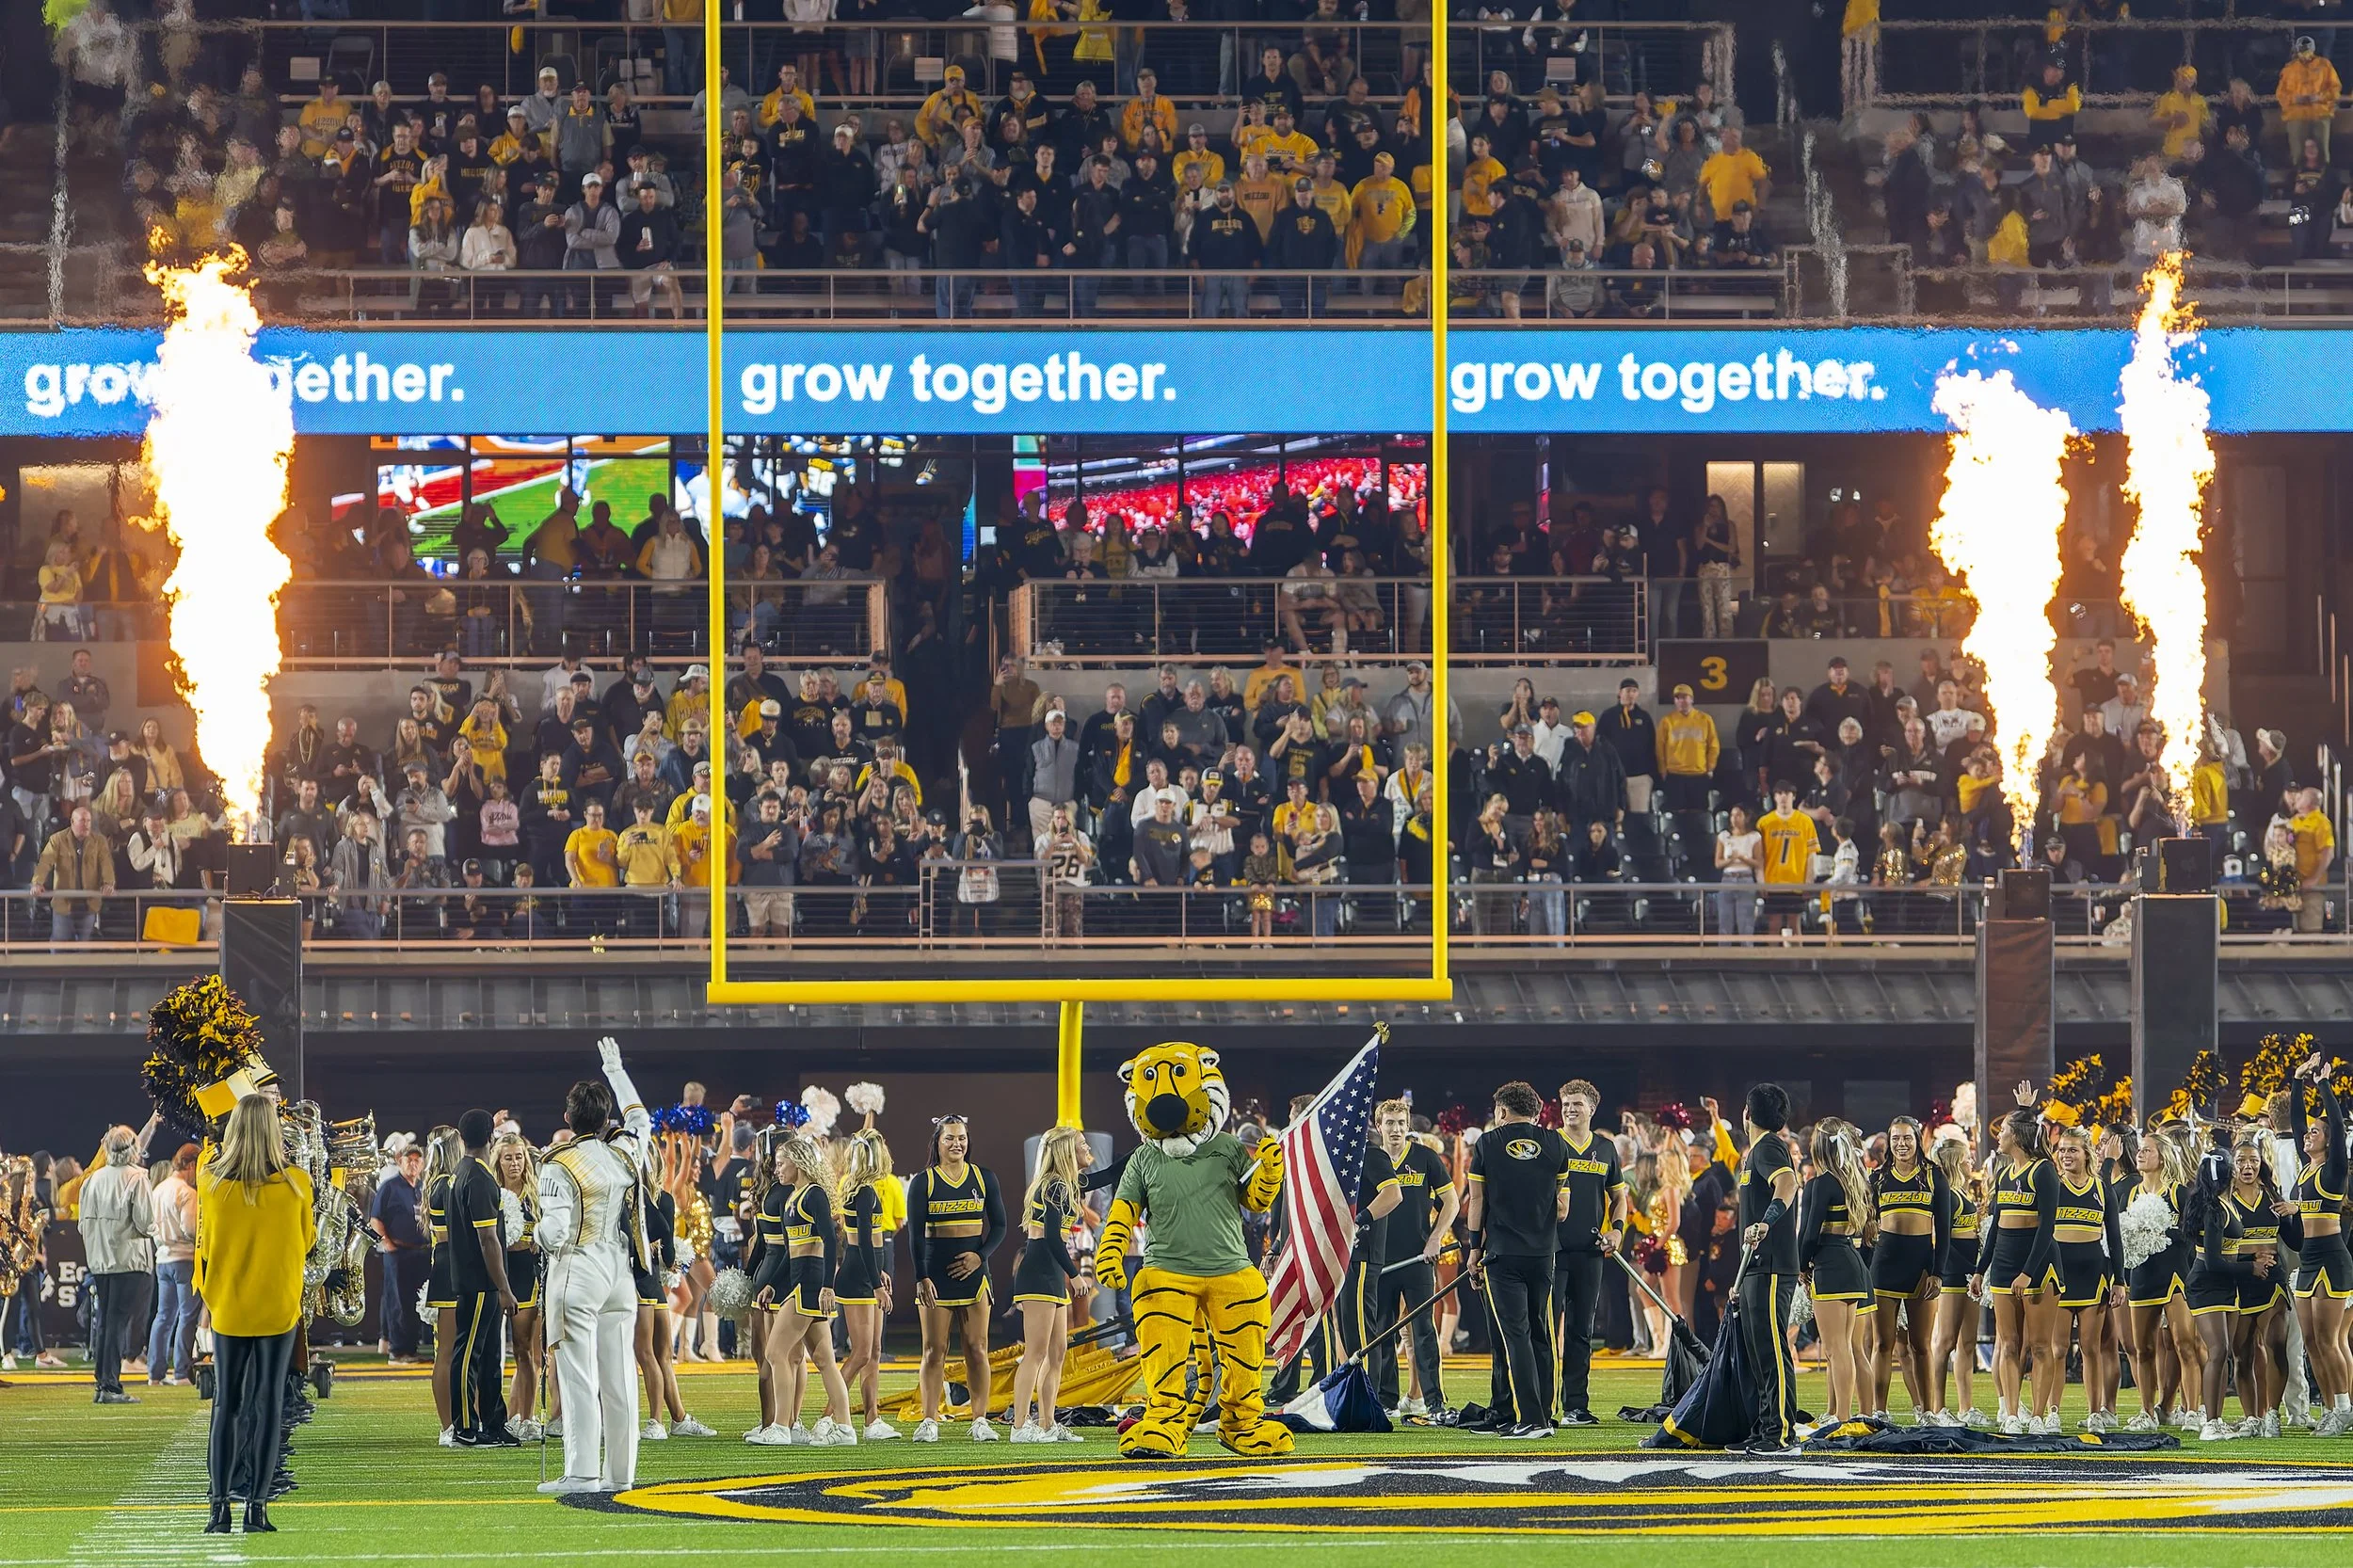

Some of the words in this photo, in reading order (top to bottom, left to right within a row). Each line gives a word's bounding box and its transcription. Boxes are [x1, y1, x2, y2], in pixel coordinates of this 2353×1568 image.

[741, 362, 895, 415] grow
[909, 351, 1176, 415] together.
[1450, 361, 1602, 414] grow
[1618, 346, 1888, 414] together.
[1699, 655, 1728, 691] 3
[1049, 854, 1080, 880] 26
[1780, 837, 1793, 865] 1
[926, 1200, 986, 1218] MIZZOU
